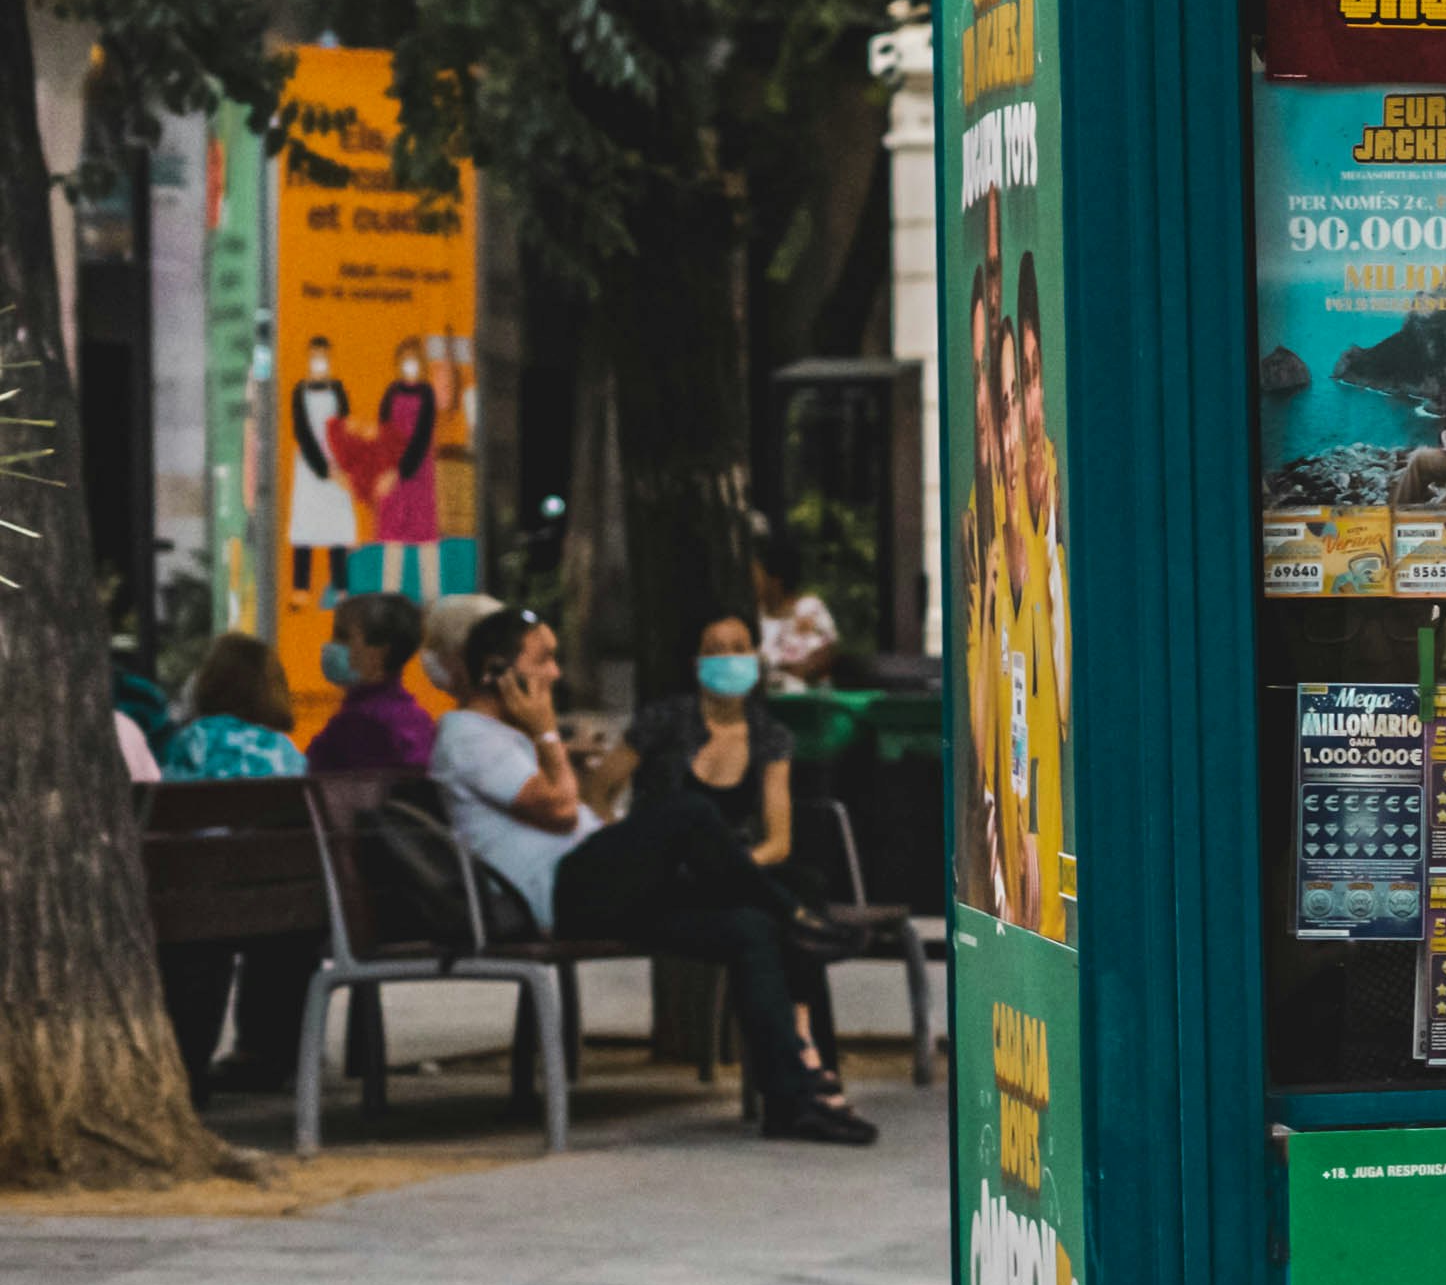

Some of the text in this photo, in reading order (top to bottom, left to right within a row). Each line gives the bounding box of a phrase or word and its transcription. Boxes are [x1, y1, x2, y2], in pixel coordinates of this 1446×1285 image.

[1004, 102, 1038, 187] TOTS
[1288, 195, 1327, 211] PER
[1331, 191, 1399, 210] NOMÉS
[1273, 565, 1319, 578] 69640
[1335, 687, 1394, 714] Mega
[1301, 713, 1422, 738] MILLONARIO
[1348, 737, 1377, 747] GANA
[1352, 1166, 1384, 1179] JUGA
